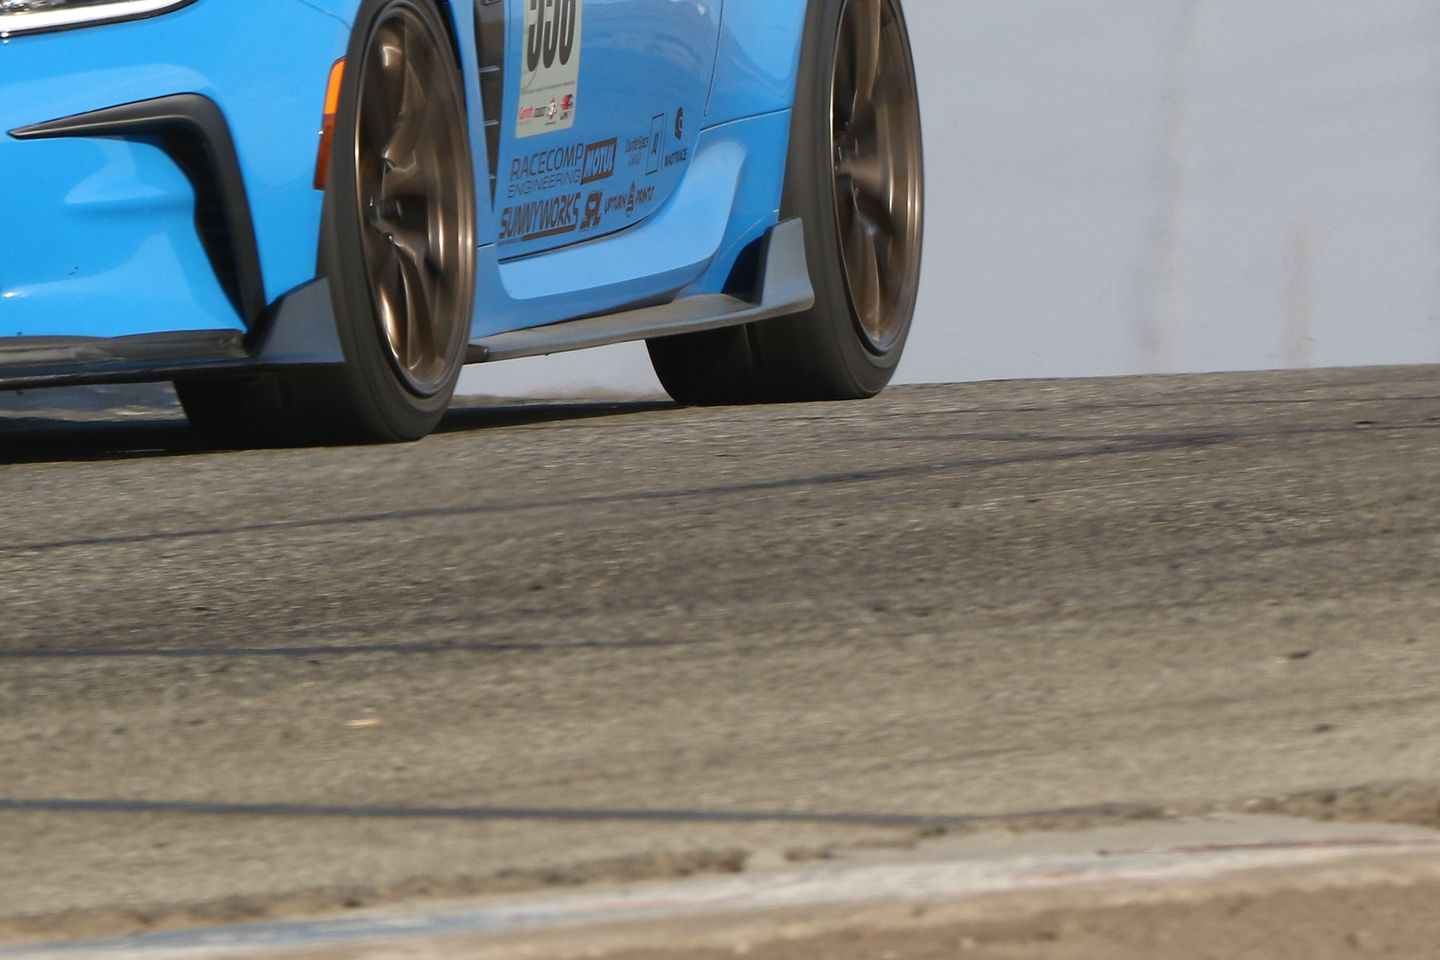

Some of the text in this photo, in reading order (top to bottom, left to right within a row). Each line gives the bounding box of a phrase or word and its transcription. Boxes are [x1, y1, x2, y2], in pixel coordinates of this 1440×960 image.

[511, 143, 585, 181] RACECOMP
[507, 170, 581, 198] ENGINEERING
[498, 192, 581, 240] SUNNYWORKS
